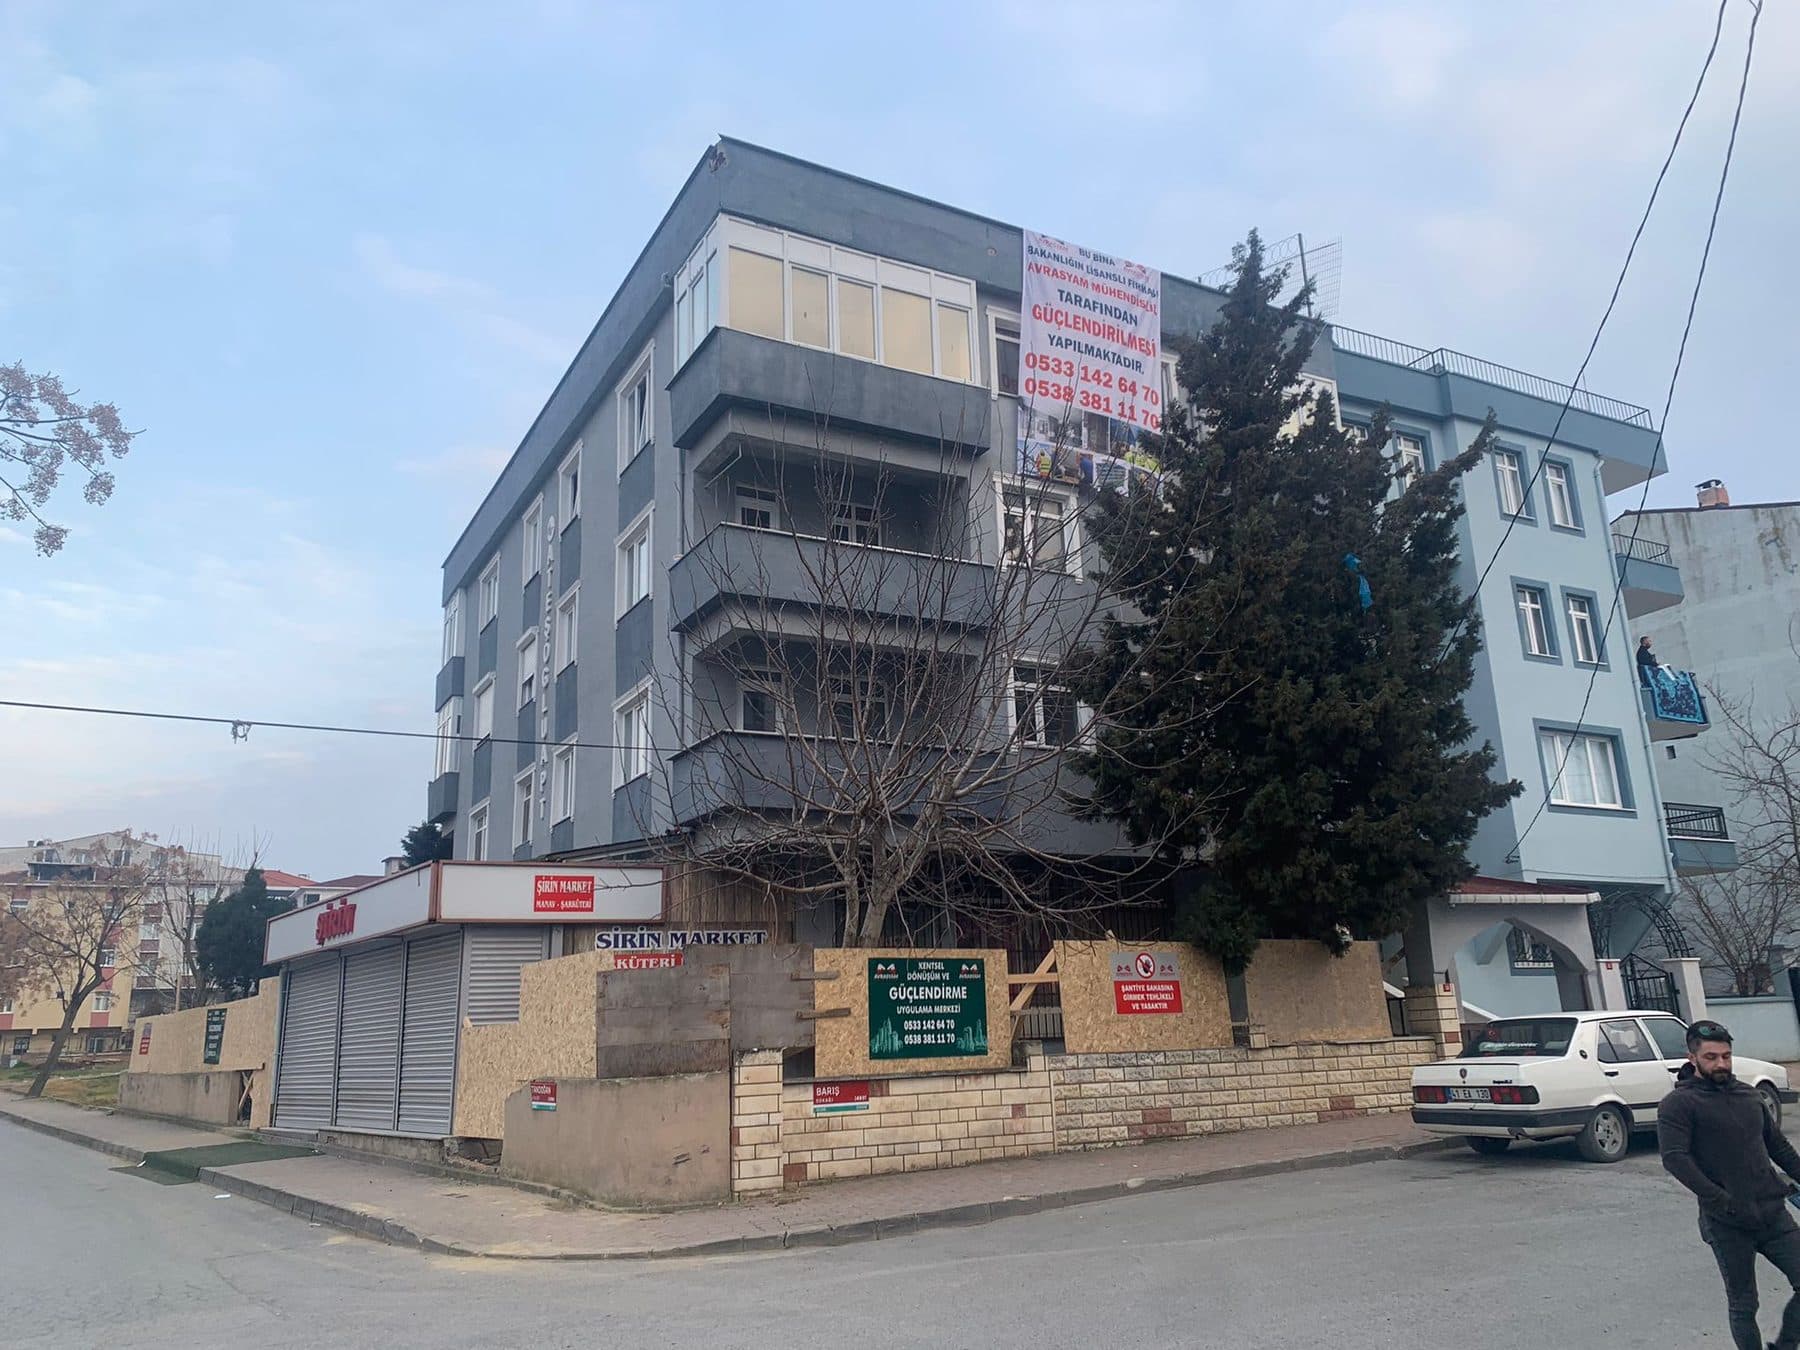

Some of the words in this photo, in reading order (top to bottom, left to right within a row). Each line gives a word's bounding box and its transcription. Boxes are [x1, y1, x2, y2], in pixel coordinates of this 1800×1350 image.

[1027, 262, 1089, 288] AVRASYAM
[1057, 289, 1138, 327] TARAFINDAN
[1032, 302, 1156, 358] GÜÇLENDİRİLMESİ
[1025, 352, 1075, 377] 0533
[1080, 365, 1113, 389] 142
[1118, 376, 1138, 397] 64
[1142, 385, 1159, 406] 70
[1025, 377, 1074, 403] 0538
[1080, 390, 1113, 414] 381
[1118, 401, 1138, 421] 11
[1142, 409, 1159, 430] 70
[536, 877, 558, 896] ŞİRİN
[559, 881, 593, 893] MARKET
[669, 931, 767, 949] MARKET
[614, 955, 676, 969] KÜTERİ
[941, 972, 950, 981] VE
[889, 983, 967, 1004] GÜÇLENDİRME
[896, 1004, 933, 1015] UYGULAMA
[903, 1020, 921, 1030] 0533
[922, 1020, 935, 1030] 142
[936, 1019, 945, 1029] 64
[946, 1019, 955, 1029] 70
[904, 1033, 921, 1045] 0538
[922, 1033, 935, 1044] 381
[937, 1033, 946, 1044] 11
[946, 1033, 955, 1044] 70
[816, 1086, 840, 1097] BARIŞ
